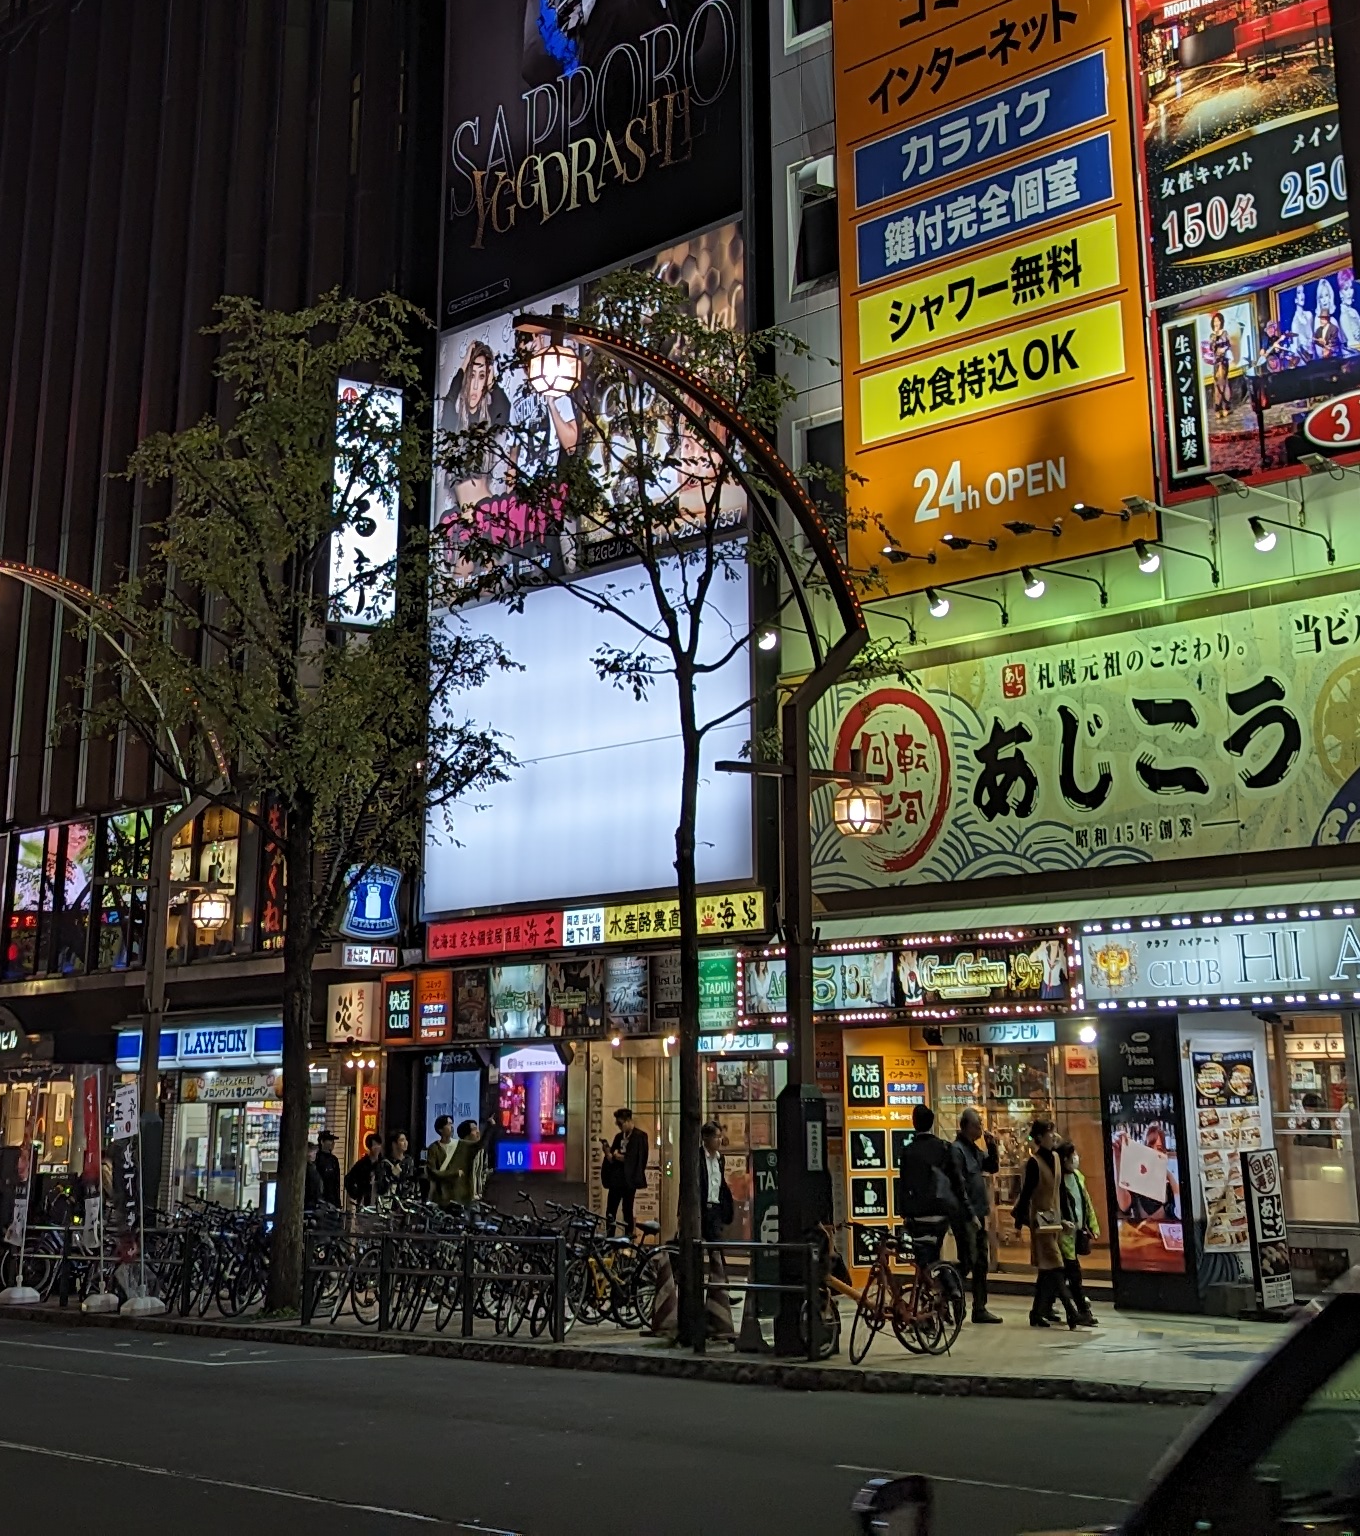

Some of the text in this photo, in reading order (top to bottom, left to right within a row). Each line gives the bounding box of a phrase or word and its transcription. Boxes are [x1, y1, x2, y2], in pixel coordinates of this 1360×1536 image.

[901, 87, 1051, 184] カラオケ
[1160, 151, 1253, 200] 女性キャスト
[883, 157, 1081, 269] 鍵付完全個室
[1161, 192, 1258, 256] 150名
[889, 238, 1083, 343] シャワー無料
[897, 329, 1079, 422] 飲食持込OK
[1173, 333, 1199, 461] 生バンド演奏
[913, 456, 1068, 524] 24h OPEN
[1036, 631, 1246, 691] 札幌元祖のこだわり。
[972, 674, 1303, 823] あじこう
[1074, 819, 1194, 849] 昭和45年創業
[351, 917, 395, 930] STATION
[565, 925, 602, 944] 地下1階
[1146, 936, 1220, 949] クラブ ハイアート
[371, 949, 396, 964] ATM
[1146, 958, 1222, 988] CLUB
[1230, 928, 1312, 984] HI
[389, 989, 411, 1012] 快活
[388, 1014, 410, 1030] CLUB
[958, 1024, 1040, 1043] No.1 グリーンビル
[183, 1028, 248, 1056] LAWSON
[1119, 1041, 1149, 1055] Dream
[894, 1057, 916, 1067] コミック
[1126, 1054, 1155, 1066] Vision
[851, 1063, 881, 1084] 快活
[852, 1084, 881, 1100] CLUB
[755, 1170, 779, 1192] TA
